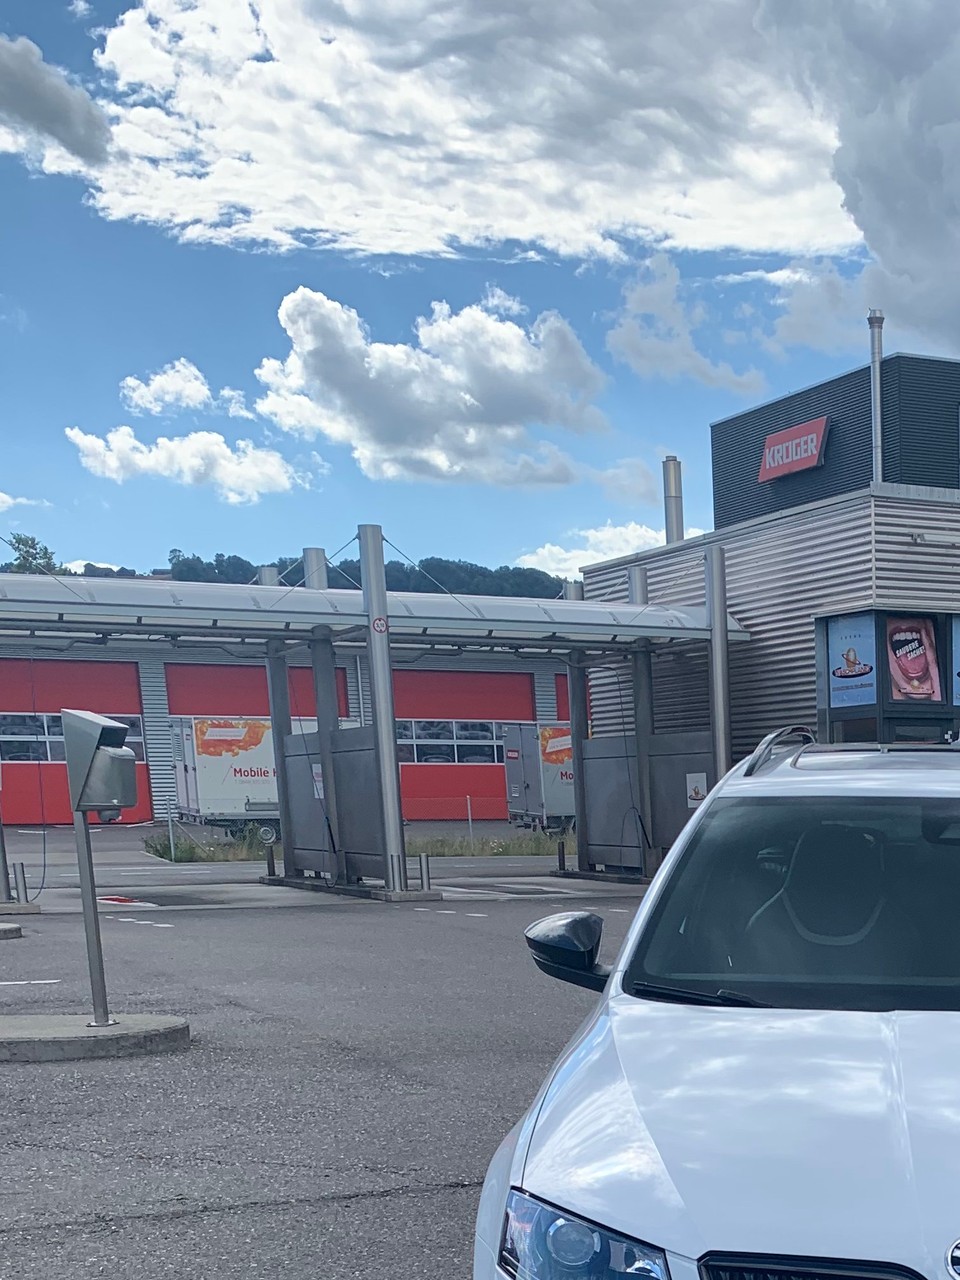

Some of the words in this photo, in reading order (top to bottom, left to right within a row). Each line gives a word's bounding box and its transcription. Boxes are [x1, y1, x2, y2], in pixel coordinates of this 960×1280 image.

[765, 433, 818, 470] KRÜGER
[895, 640, 919, 658] SAUBERE
[233, 767, 270, 778] Mobile
